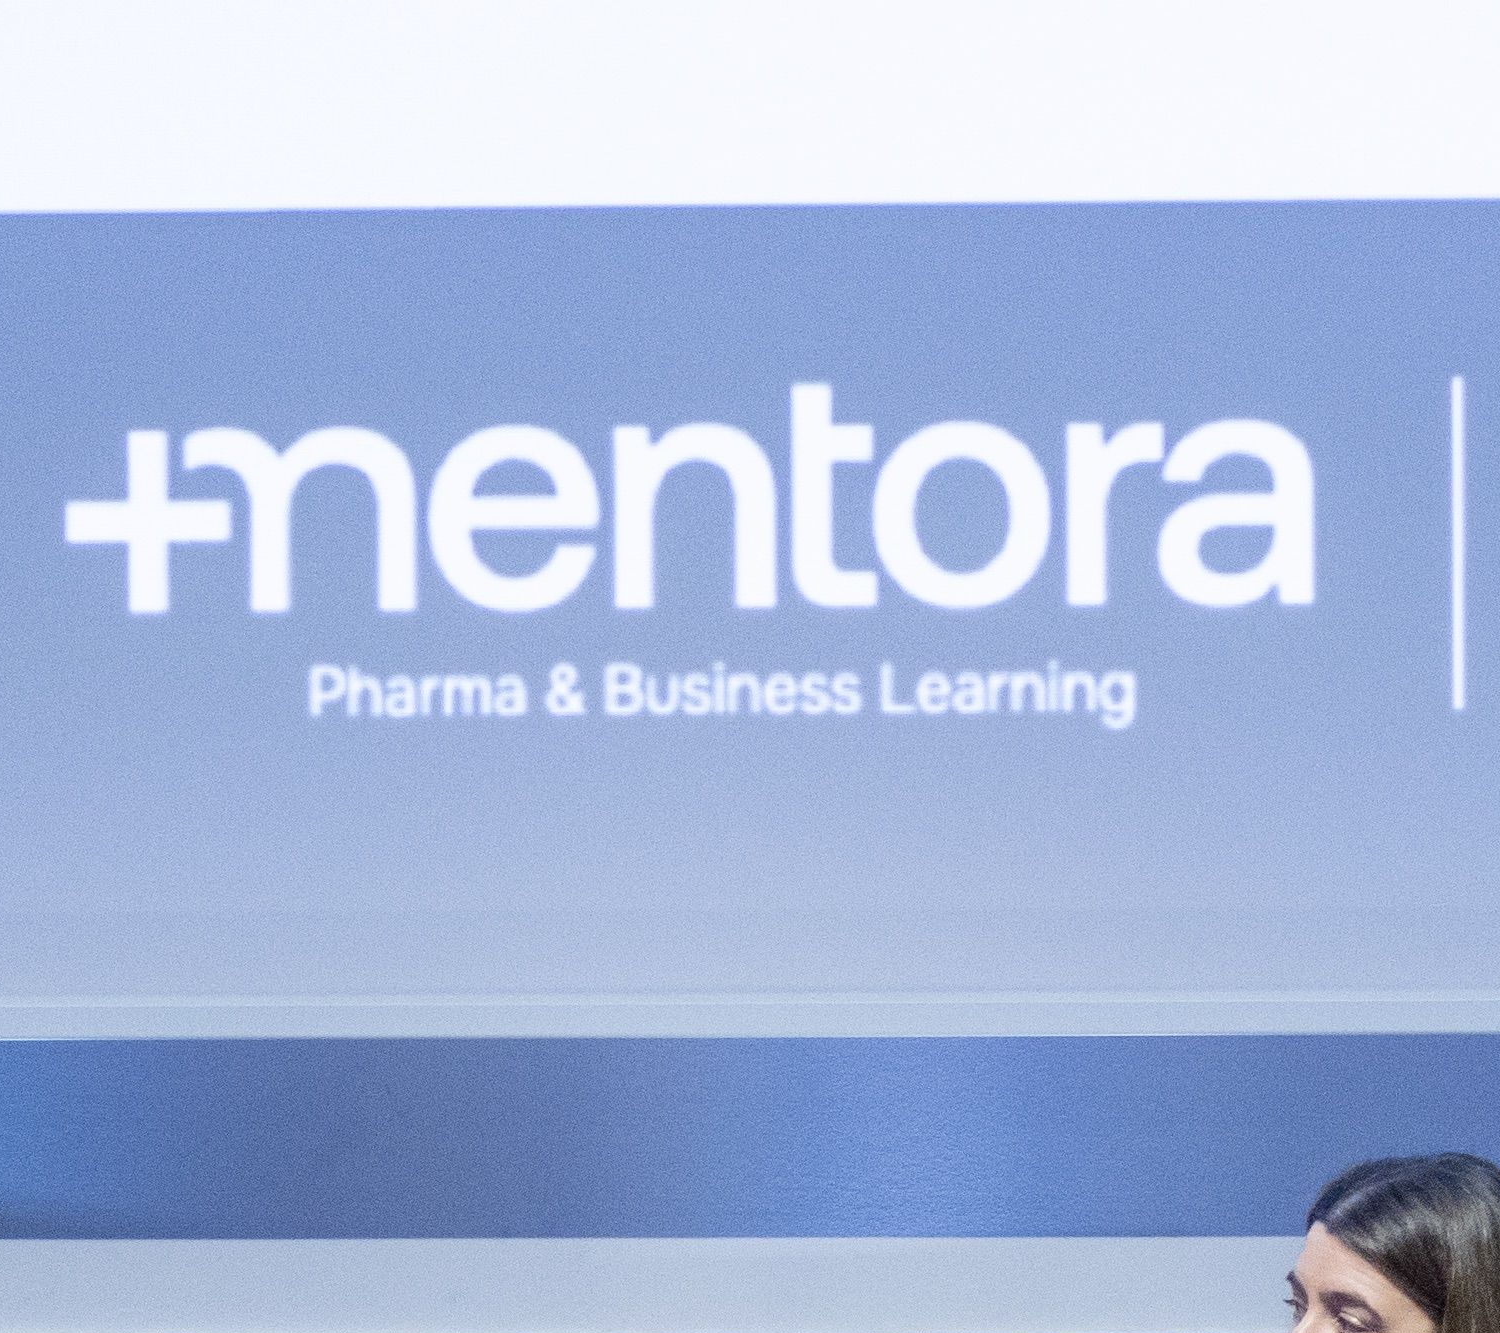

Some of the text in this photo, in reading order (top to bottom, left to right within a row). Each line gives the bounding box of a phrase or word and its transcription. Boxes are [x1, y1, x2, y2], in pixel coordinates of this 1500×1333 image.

[307, 662, 1138, 731] Pharma & Business Learning
